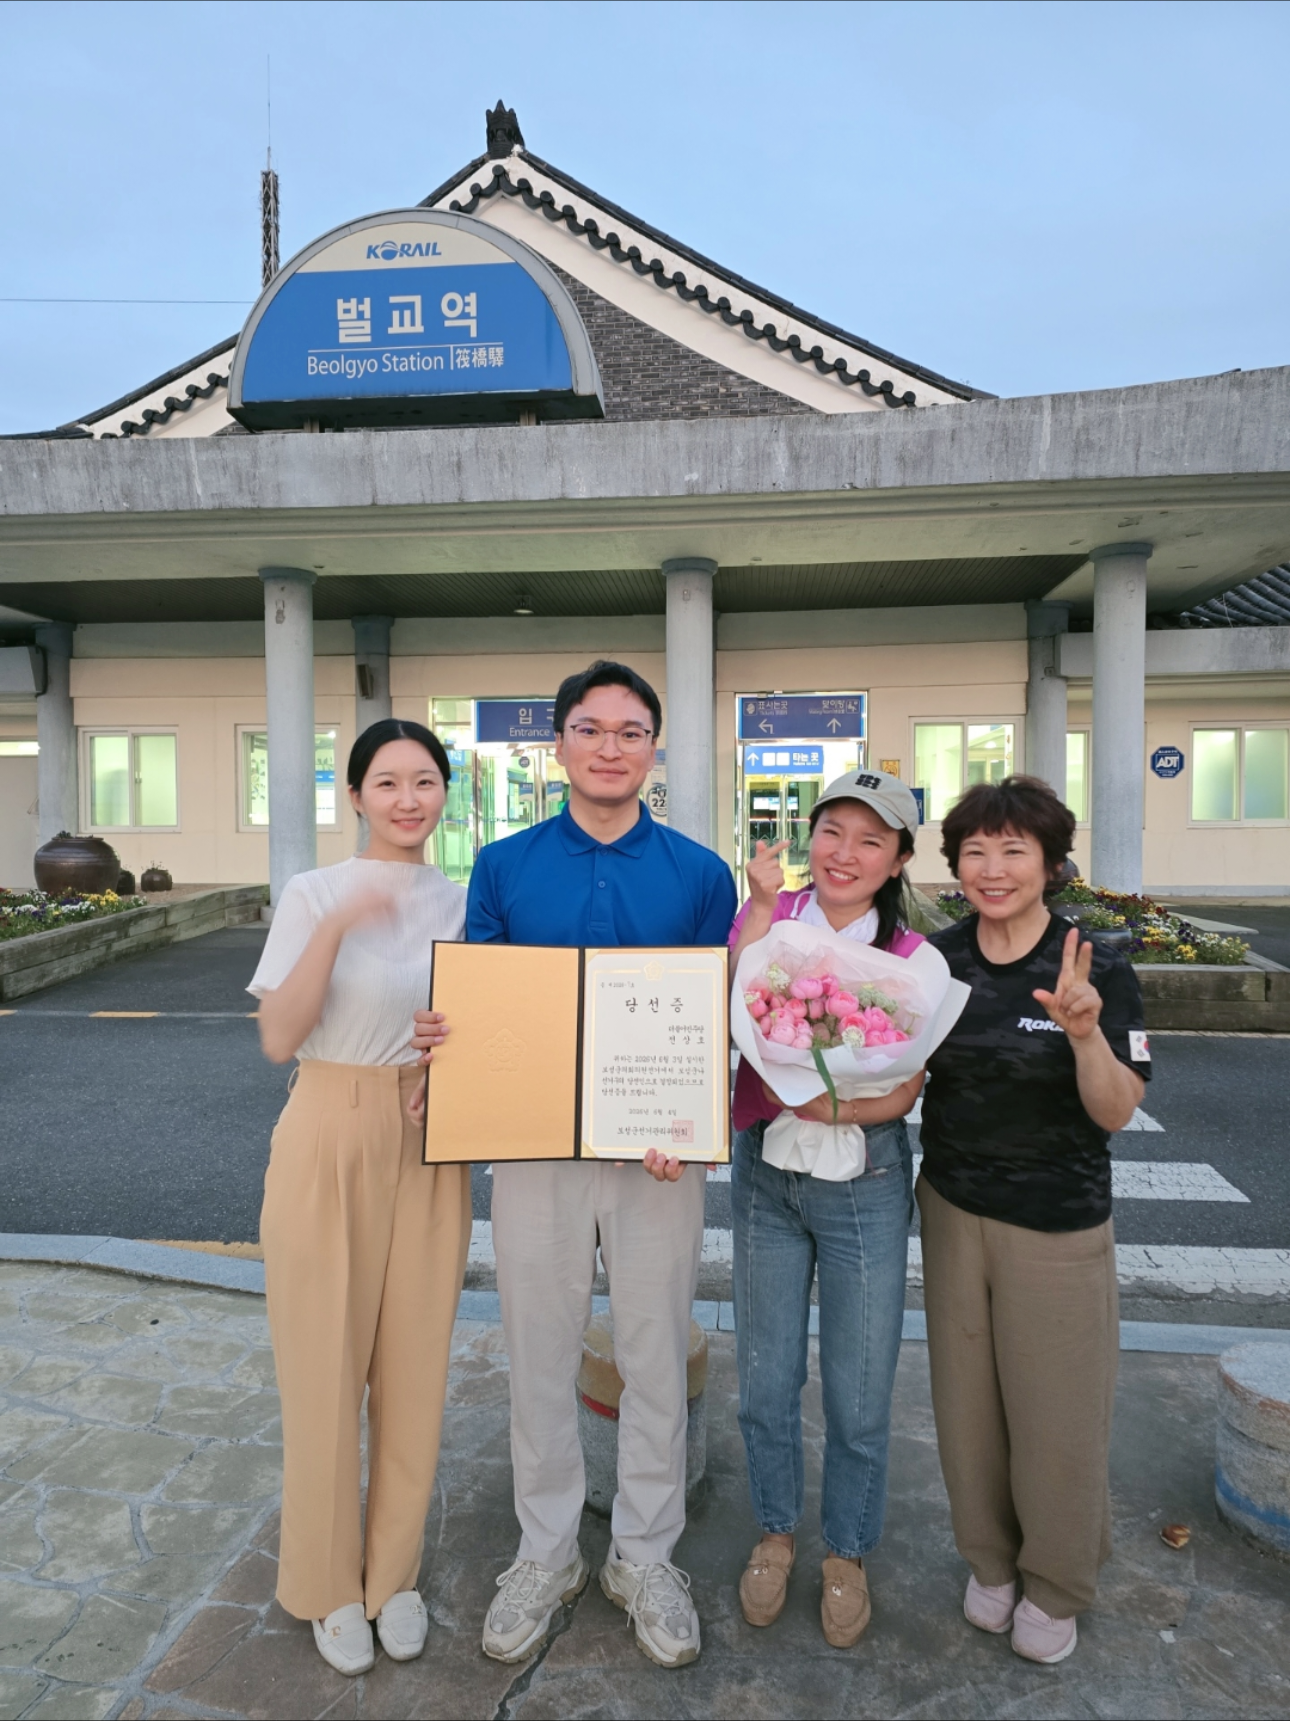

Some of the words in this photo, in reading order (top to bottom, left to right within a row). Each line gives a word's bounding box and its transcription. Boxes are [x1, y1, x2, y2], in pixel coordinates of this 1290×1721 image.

[366, 241, 442, 261] KORAIL
[337, 292, 478, 344] 벌교역
[308, 354, 378, 379] Beolgyo
[382, 353, 444, 372] Station
[510, 727, 550, 737] Entrance
[1156, 756, 1179, 768] ADT
